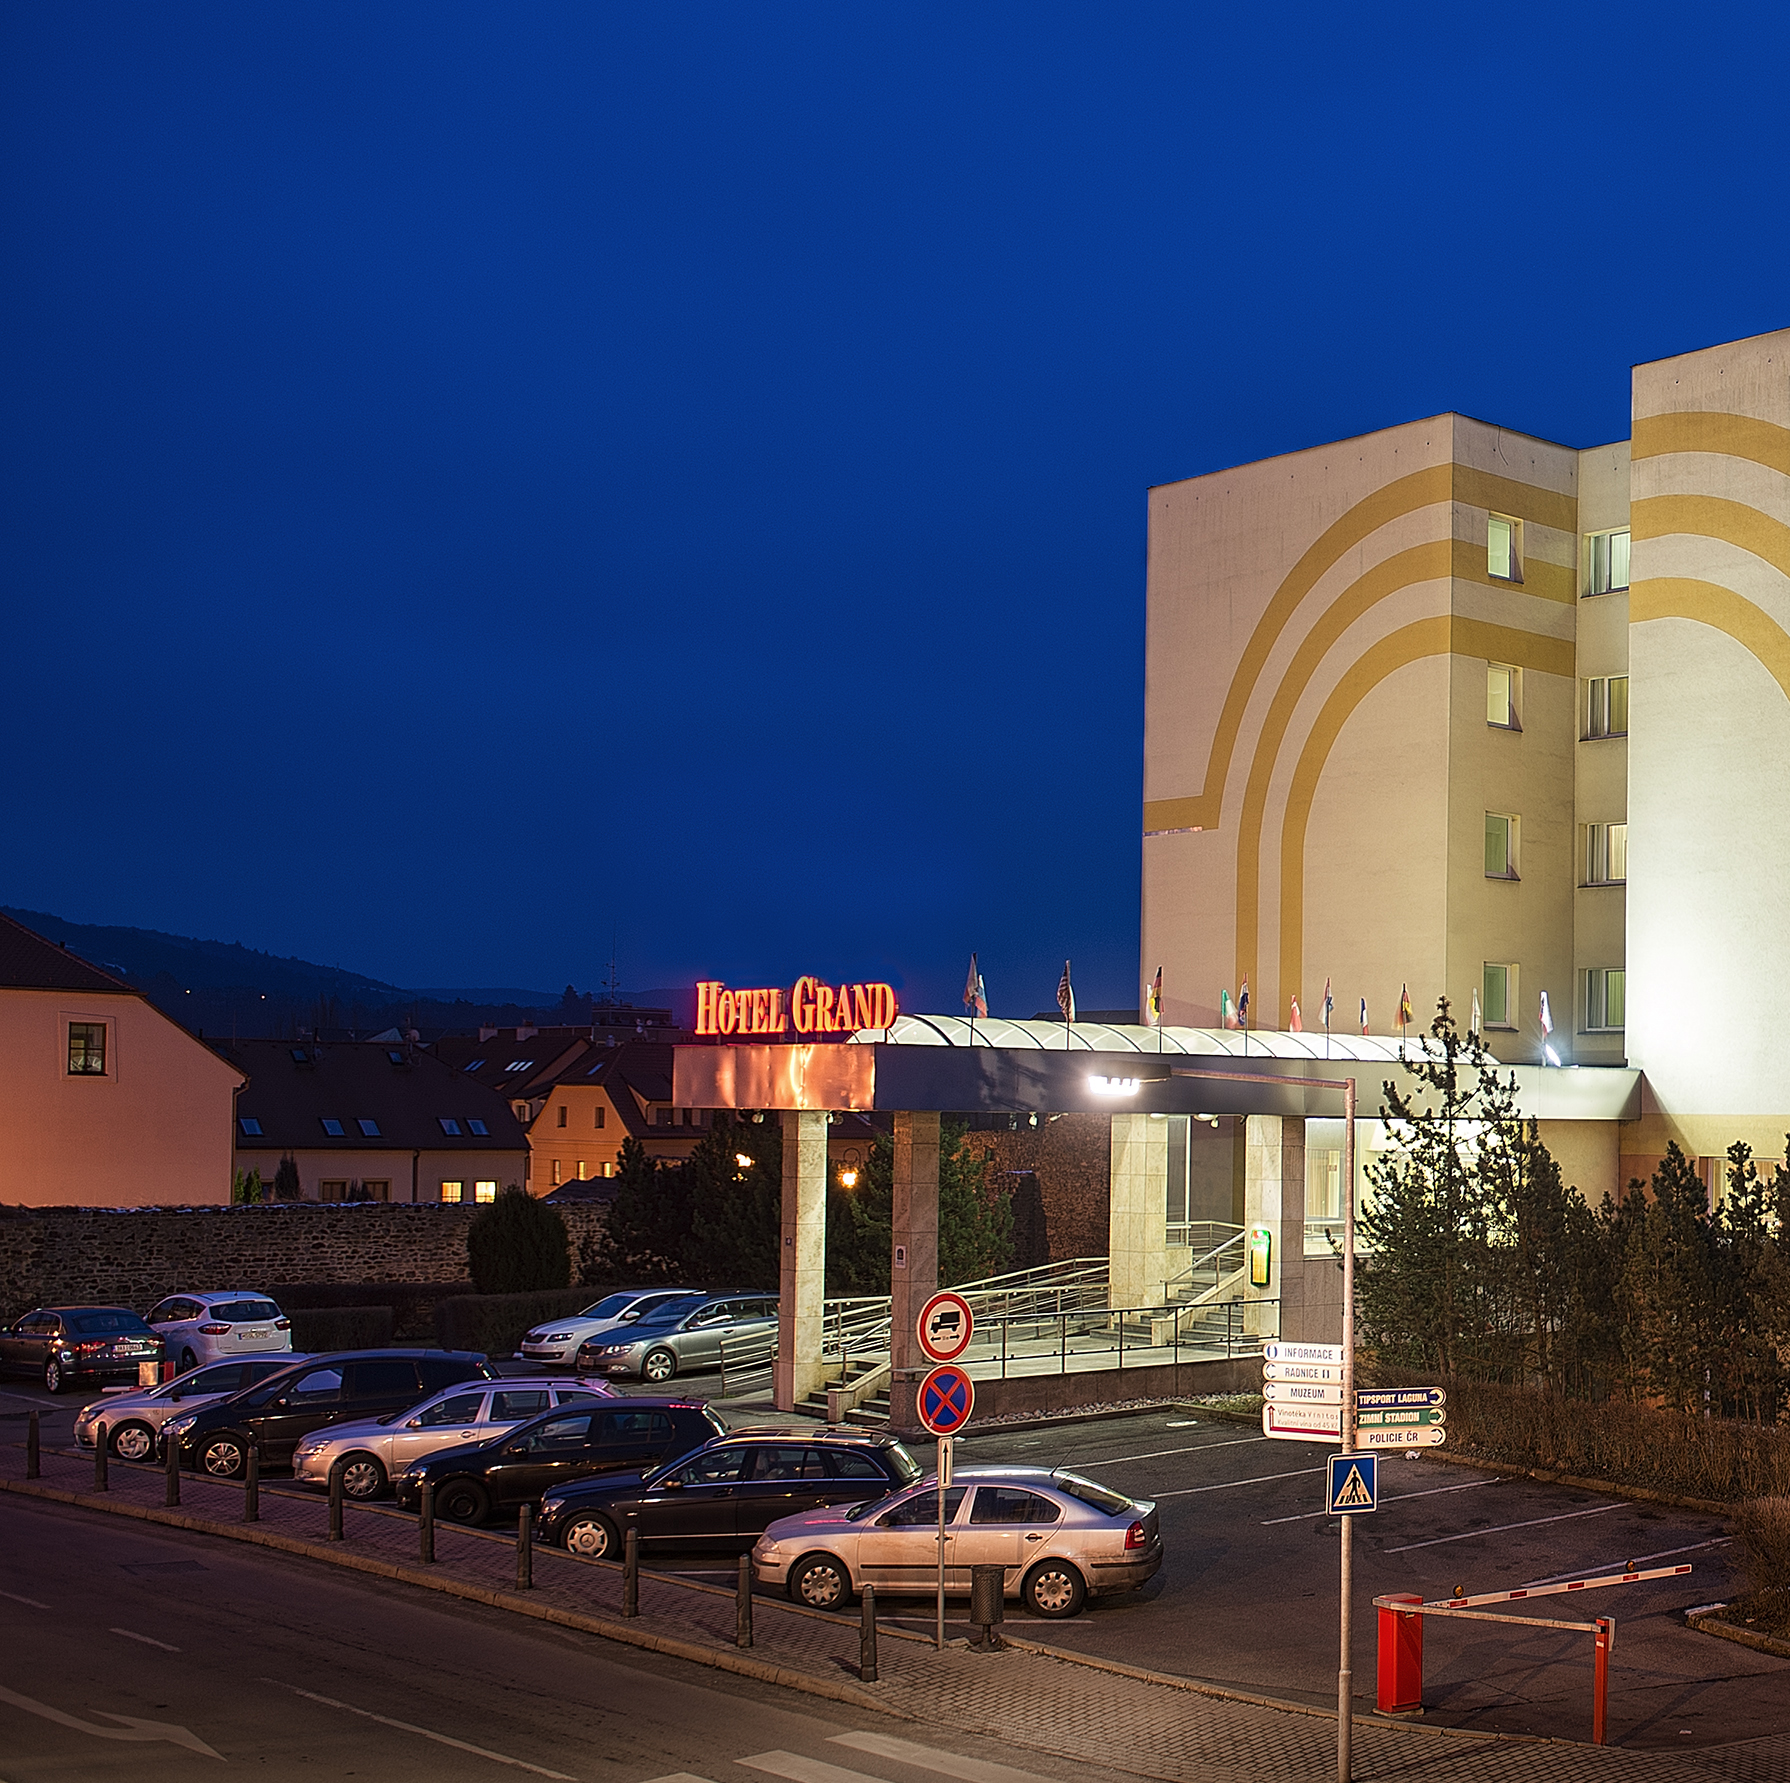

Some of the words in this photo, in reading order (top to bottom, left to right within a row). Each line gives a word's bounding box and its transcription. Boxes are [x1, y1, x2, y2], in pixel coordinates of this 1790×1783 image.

[694, 981, 786, 1035] HOTEL
[792, 975, 895, 1033] GRAND
[1284, 1347, 1333, 1360] INFORMACE
[1284, 1367, 1319, 1379] RADNICE
[1290, 1388, 1325, 1399] MUZEUM
[1358, 1394, 1396, 1405] TIPSPORT
[1397, 1392, 1428, 1403] LAGUNA
[1277, 1408, 1306, 1417] Vinotéka
[1358, 1411, 1384, 1425] ZIMNÍ
[1384, 1411, 1420, 1424] STADION
[1369, 1432, 1403, 1443] POLICIE
[1406, 1429, 1418, 1442] ČR
